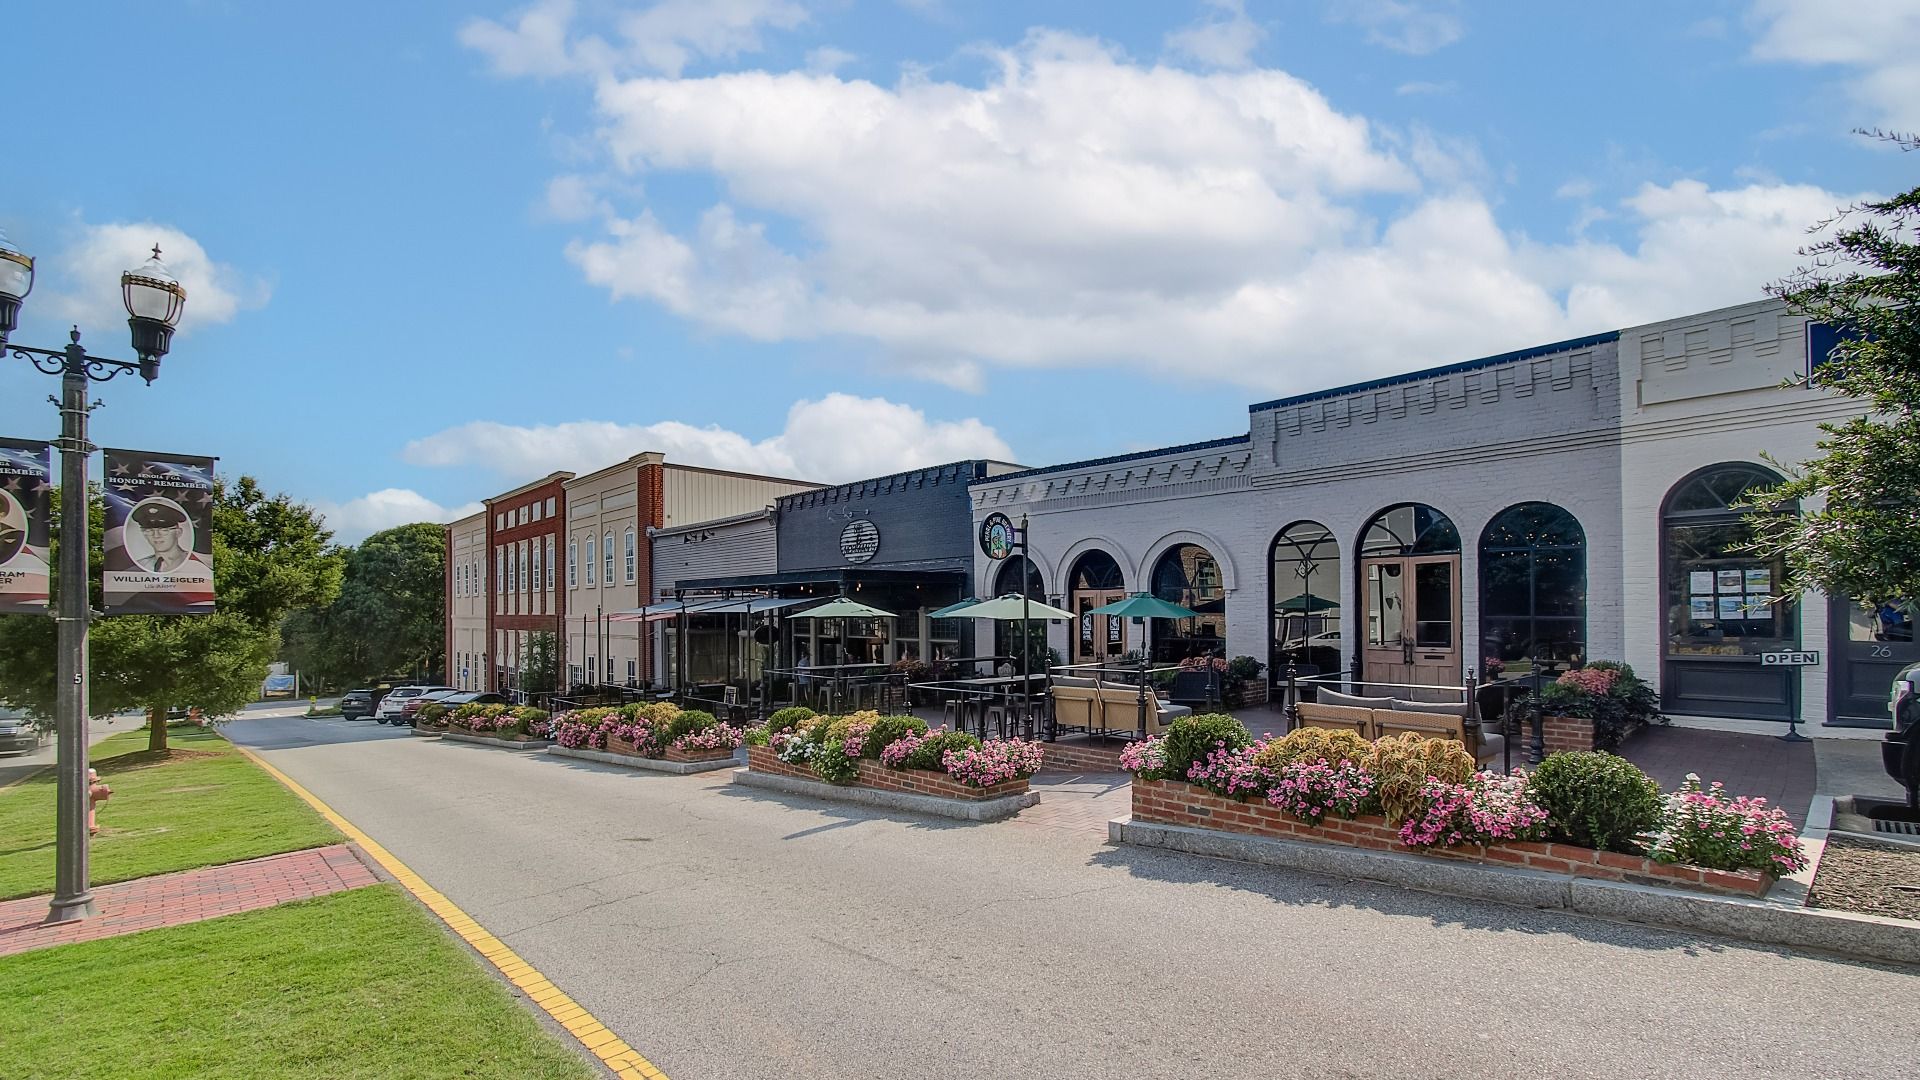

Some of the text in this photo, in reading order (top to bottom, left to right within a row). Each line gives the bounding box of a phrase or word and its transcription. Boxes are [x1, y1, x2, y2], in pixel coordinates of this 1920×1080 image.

[109, 476, 145, 485] HONOR
[154, 480, 208, 490] REMEMBER
[113, 575, 205, 584] WILLIAM ZEIGLER
[1870, 645, 1892, 658] 26
[1764, 653, 1815, 664] OPEN
[74, 673, 82, 684] 5
